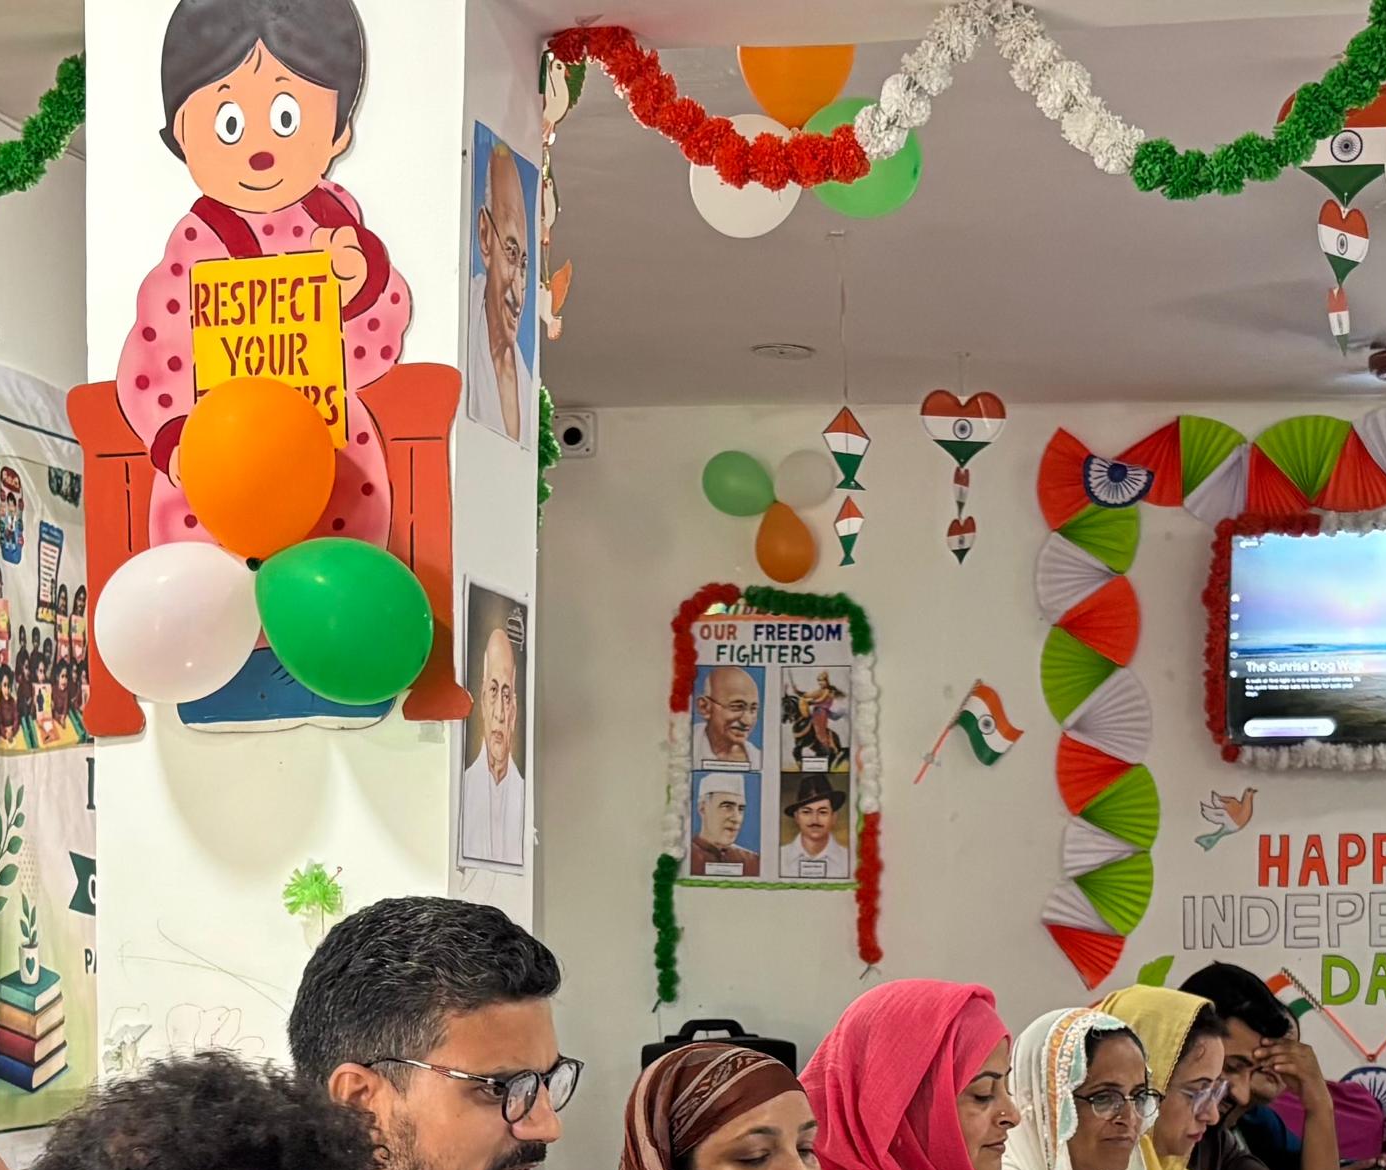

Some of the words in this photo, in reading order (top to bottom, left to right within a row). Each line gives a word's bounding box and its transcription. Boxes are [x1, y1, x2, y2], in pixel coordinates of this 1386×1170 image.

[194, 274, 327, 327] RESPECT
[220, 332, 309, 377] YOUR
[699, 623, 738, 641] OUR
[753, 623, 842, 641] FREEDOM
[716, 644, 816, 666] FIGHTERS
[1245, 661, 1267, 673] The
[1268, 661, 1310, 673] Sunrise
[1310, 660, 1335, 674] Dog
